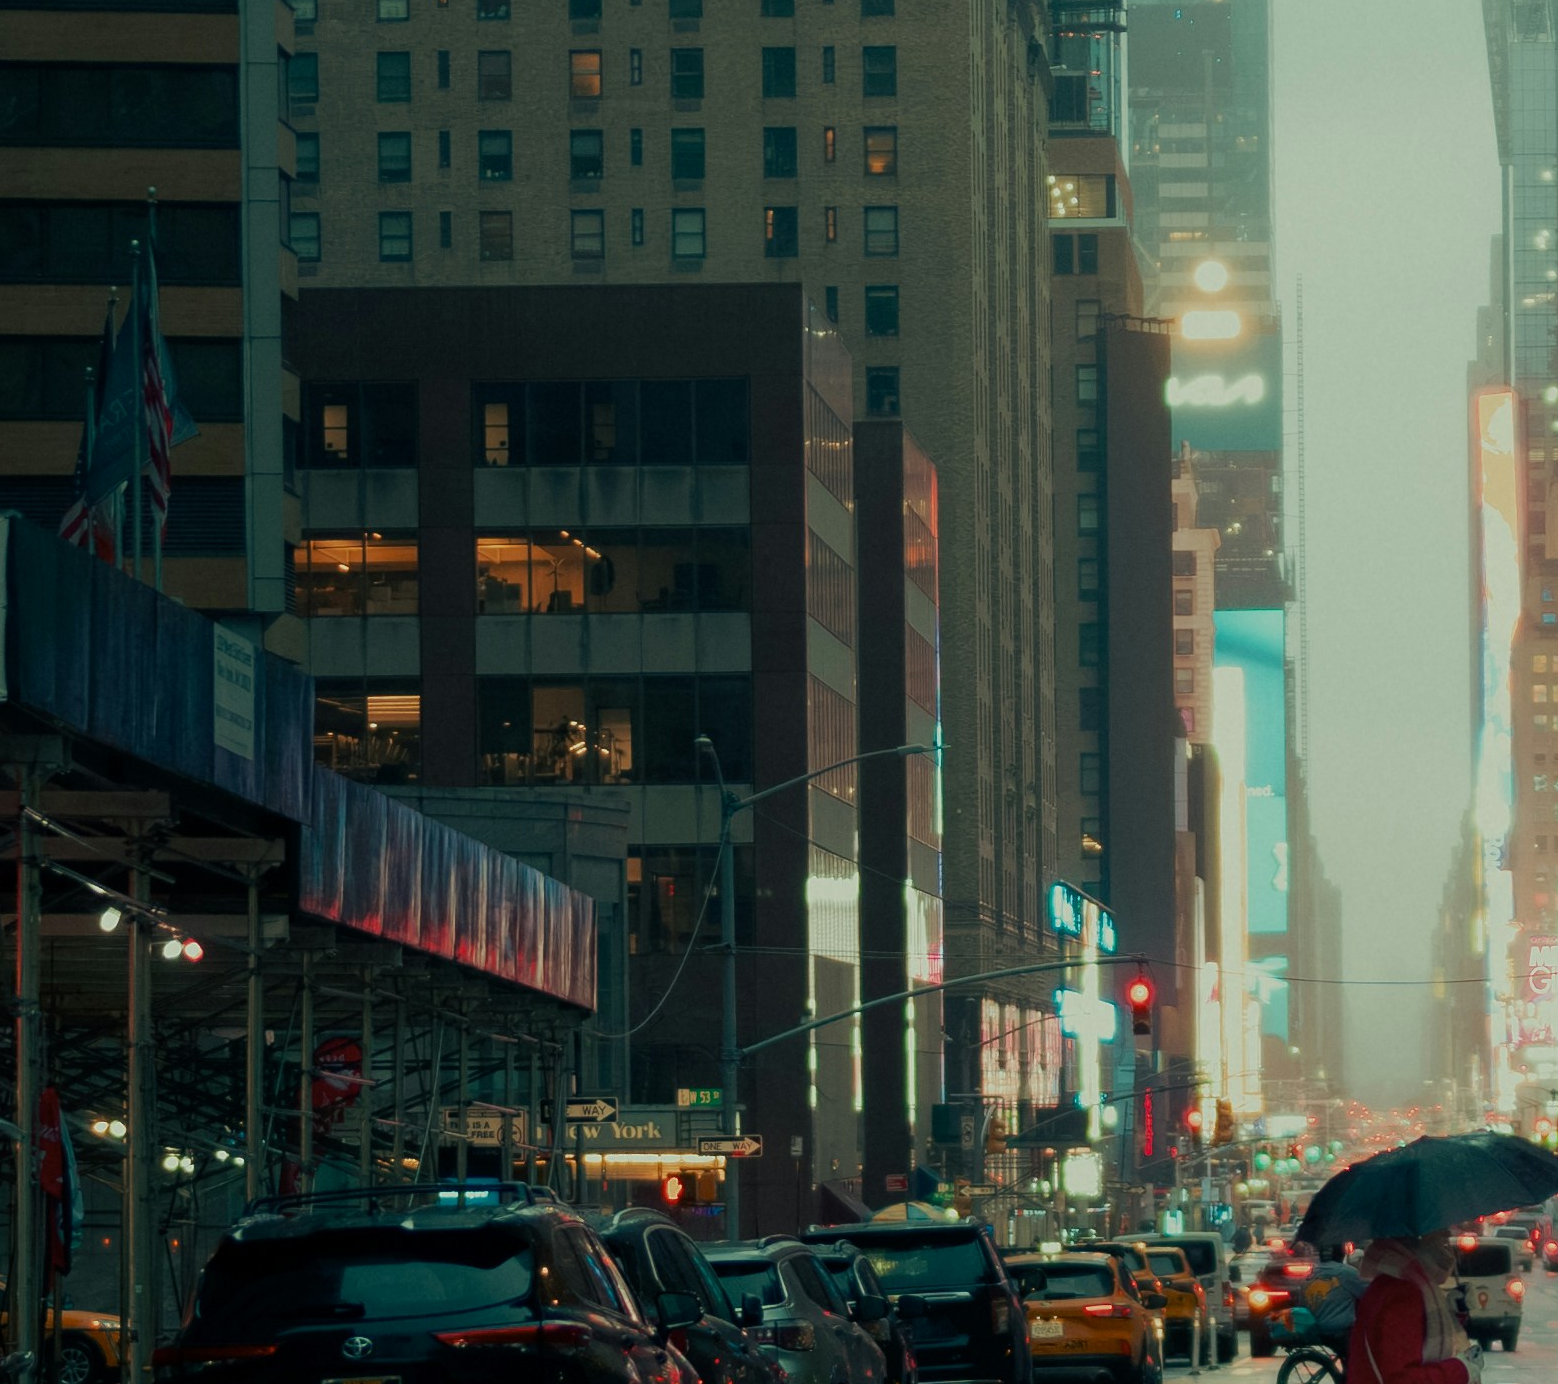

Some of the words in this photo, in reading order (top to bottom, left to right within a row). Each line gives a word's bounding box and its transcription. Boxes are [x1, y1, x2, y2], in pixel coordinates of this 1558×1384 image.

[699, 1090, 711, 1104] 53
[582, 1105, 606, 1116] WAY
[471, 1130, 495, 1139] FREE
[610, 1122, 663, 1140] York
[703, 1141, 722, 1152] ONE
[732, 1140, 753, 1152] WAY
